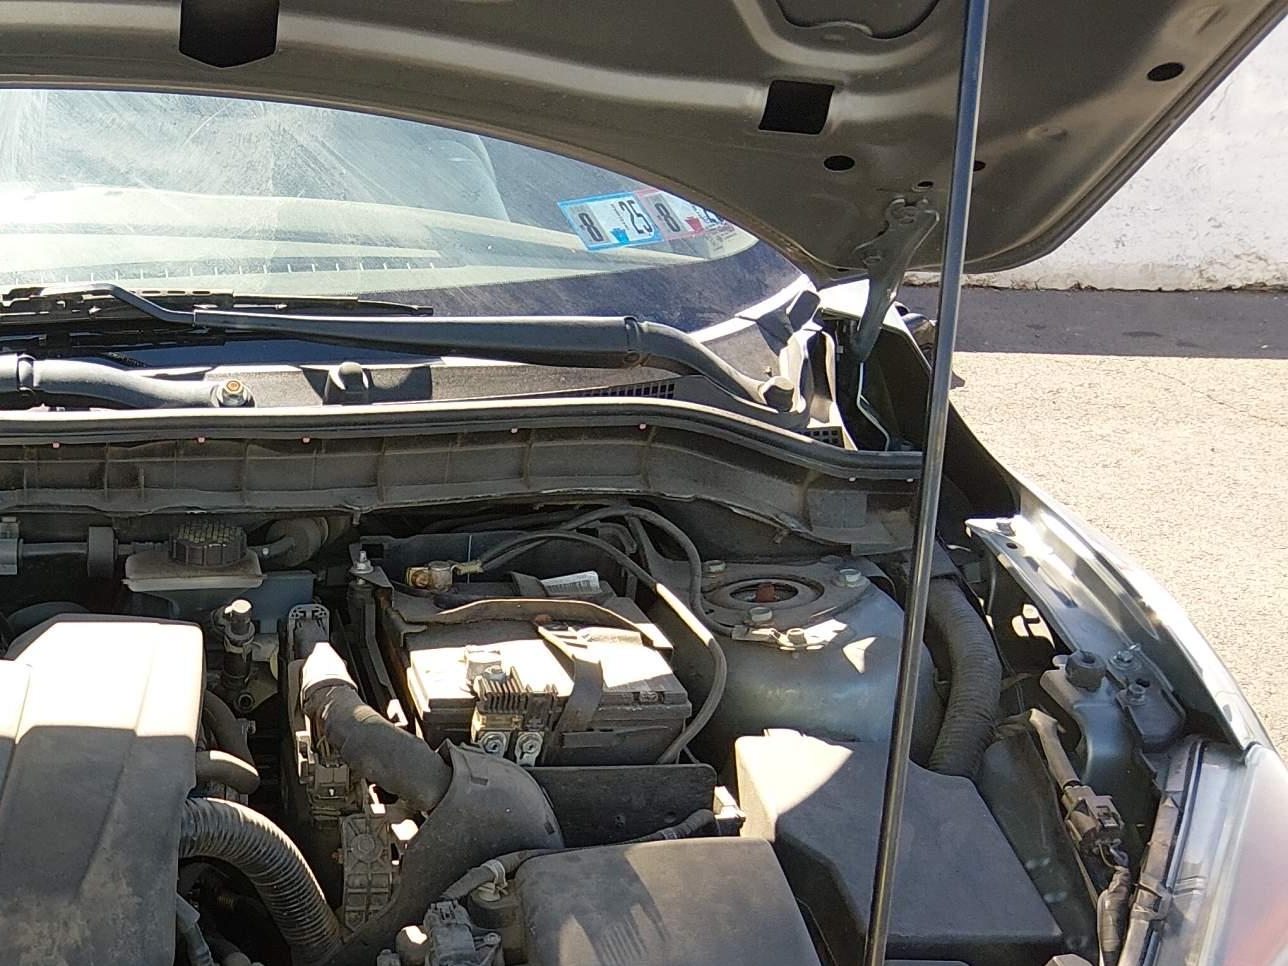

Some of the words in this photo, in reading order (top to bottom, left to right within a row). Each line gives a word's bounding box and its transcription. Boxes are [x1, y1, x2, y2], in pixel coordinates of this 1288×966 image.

[578, 213, 604, 242] 8
[618, 200, 653, 234] 25
[655, 203, 681, 232] 8
